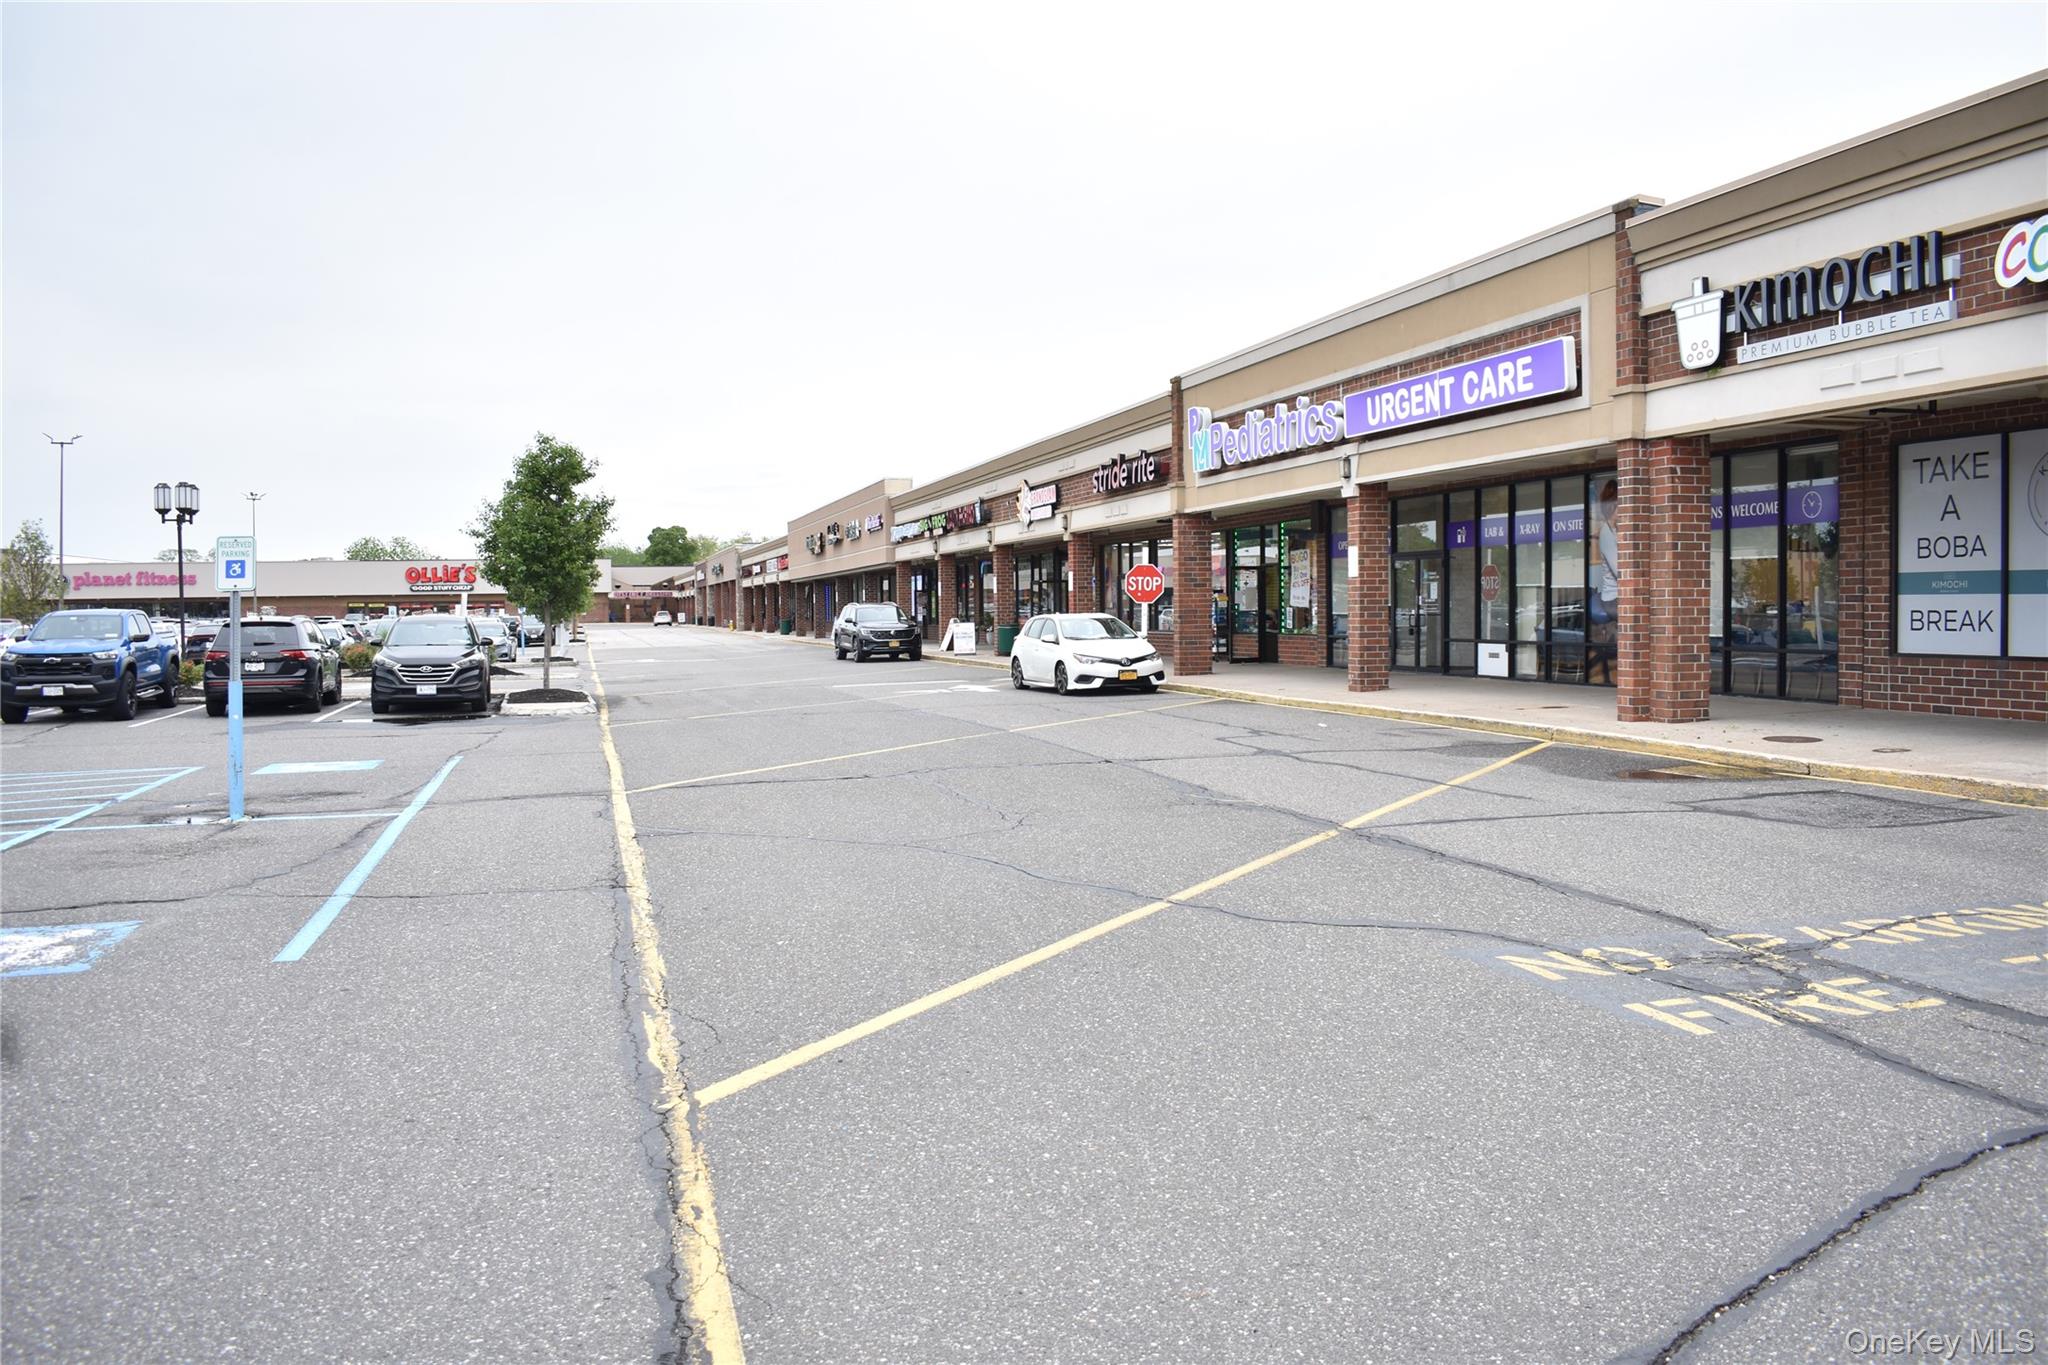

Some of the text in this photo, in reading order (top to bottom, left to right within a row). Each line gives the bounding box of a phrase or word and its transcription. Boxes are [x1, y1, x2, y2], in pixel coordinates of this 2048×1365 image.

[1734, 231, 1944, 334] KIMOCHI
[1741, 305, 1946, 361] PREMIUM BUBBLE TEA
[1366, 356, 1534, 427] URGENT CARE
[1210, 396, 1338, 467] Pediatrics
[1092, 451, 1156, 494] stride rite
[1913, 452, 1989, 484] TAKE
[931, 513, 947, 529] FROG
[1731, 501, 1779, 517] WELCOME
[1940, 494, 1961, 522] A
[1484, 527, 1505, 538] LAB &
[1519, 524, 1541, 535] X-RAY
[1553, 519, 1584, 532] ON SITE
[1917, 534, 1987, 560] BOBA
[73, 571, 198, 591] planet fitness
[1128, 577, 1162, 591] STOP
[1931, 580, 1968, 590] KIMOCHI
[1910, 609, 1994, 633] BREAK
[1495, 946, 1675, 981] NO
[1622, 976, 1948, 1036] FIRE
